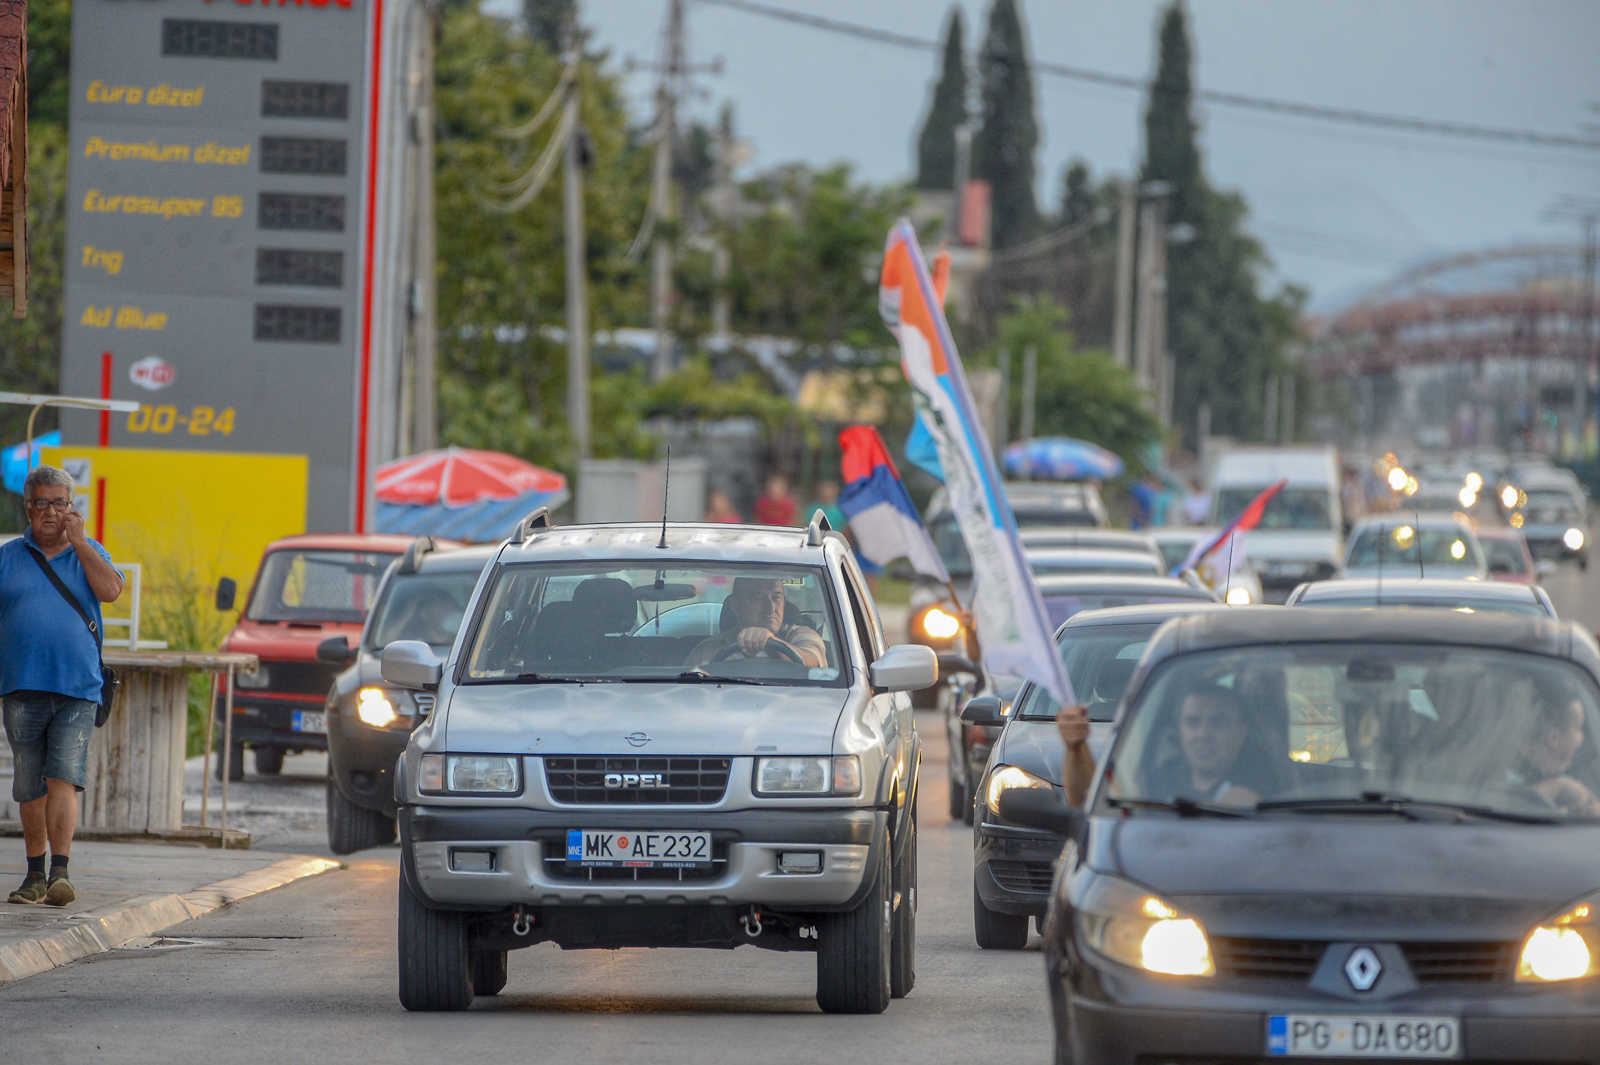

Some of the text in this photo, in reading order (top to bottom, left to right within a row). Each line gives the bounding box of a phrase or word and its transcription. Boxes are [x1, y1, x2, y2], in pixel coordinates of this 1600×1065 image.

[87, 80, 204, 107] Euro dizel
[84, 136, 251, 165] Premium dizel
[83, 189, 243, 220] Eurosuper 95
[81, 305, 168, 331] Ad Blue
[126, 404, 236, 436] 00-24
[303, 715, 322, 731] PG
[604, 774, 671, 789] OPEL
[568, 834, 706, 857] MNE MK AE232
[1292, 1021, 1331, 1051] PG
[1353, 1021, 1452, 1052] DA680
